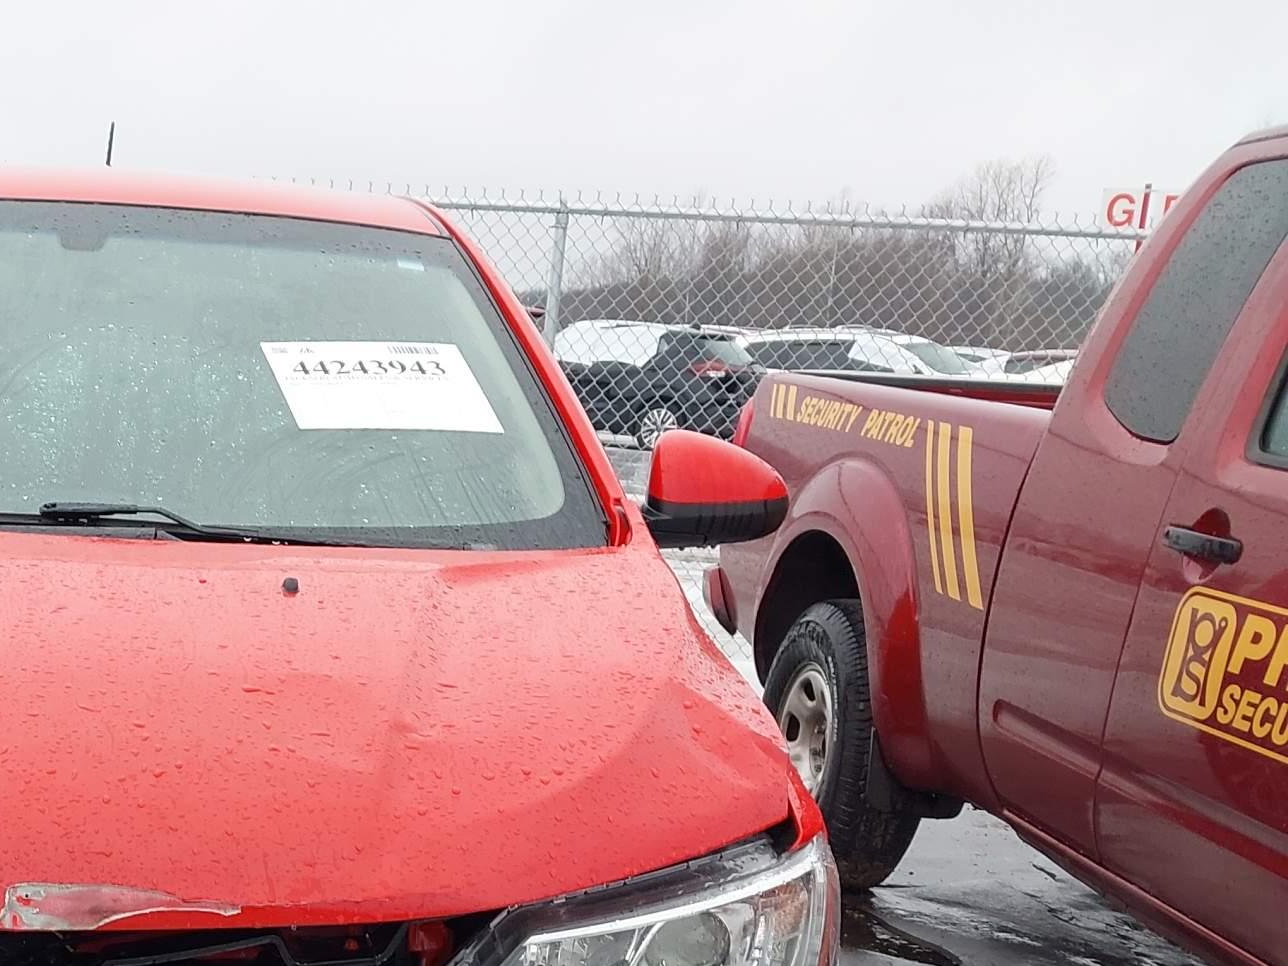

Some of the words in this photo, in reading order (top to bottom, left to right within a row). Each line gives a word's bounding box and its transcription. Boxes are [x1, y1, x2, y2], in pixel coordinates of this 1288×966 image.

[292, 360, 447, 375] 44243943
[797, 396, 863, 432] SECURITY
[861, 409, 920, 448] PATROL
